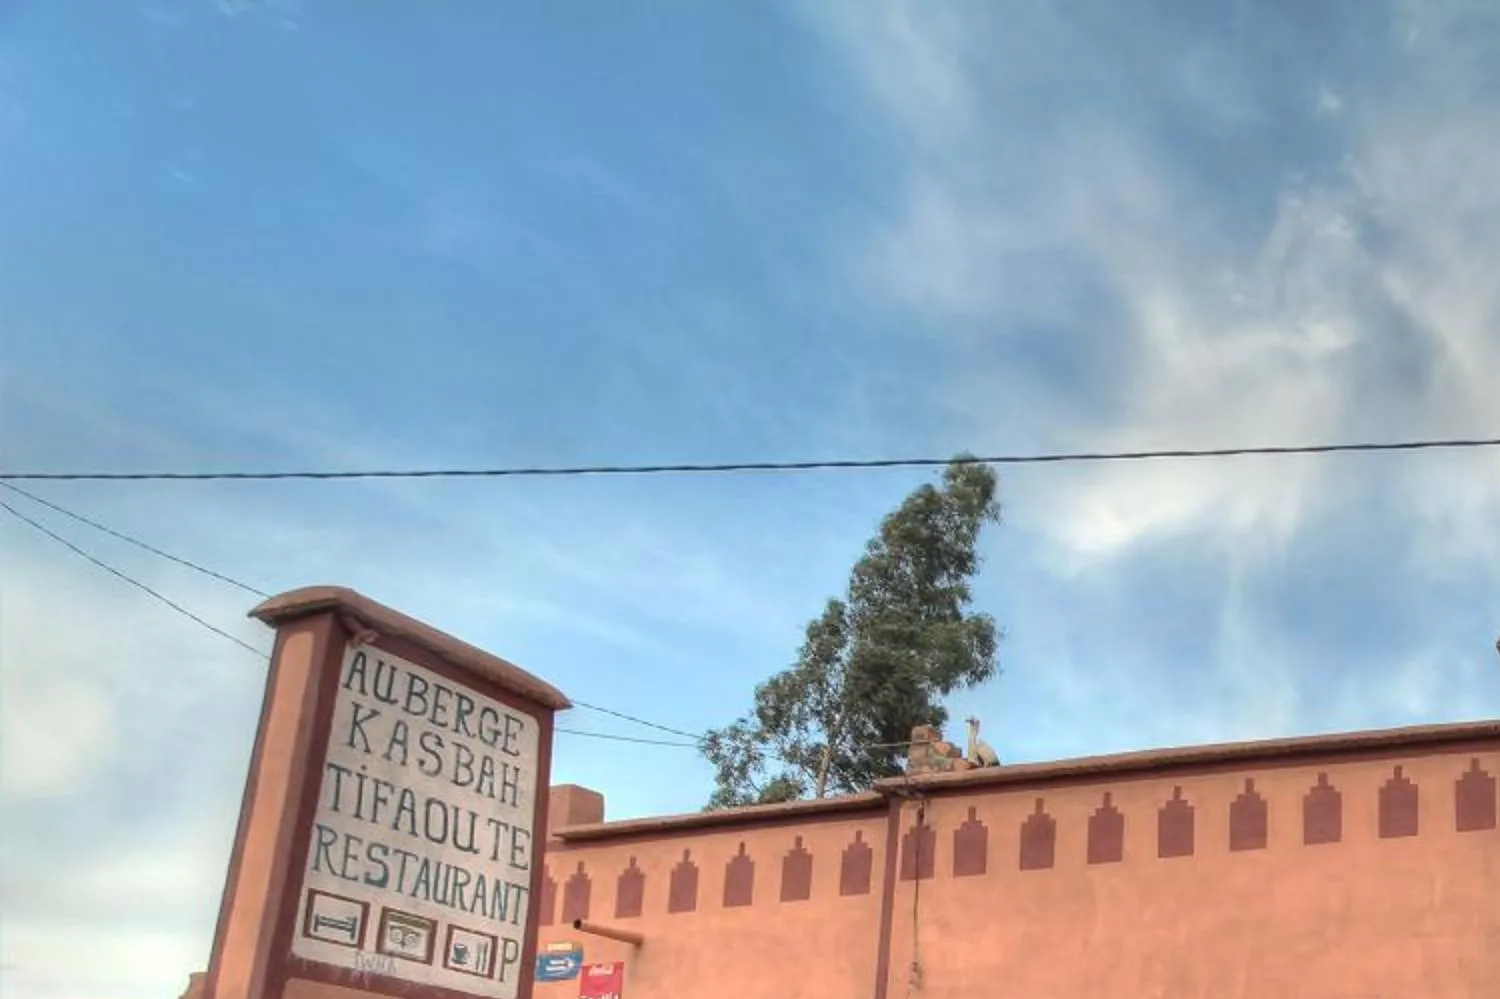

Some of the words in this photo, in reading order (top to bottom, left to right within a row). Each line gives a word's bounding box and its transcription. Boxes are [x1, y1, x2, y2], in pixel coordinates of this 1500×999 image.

[343, 651, 524, 757] AUBERGE
[347, 701, 521, 808] KASBAH
[311, 823, 529, 926] RESTAURANT
[500, 937, 520, 982] P
